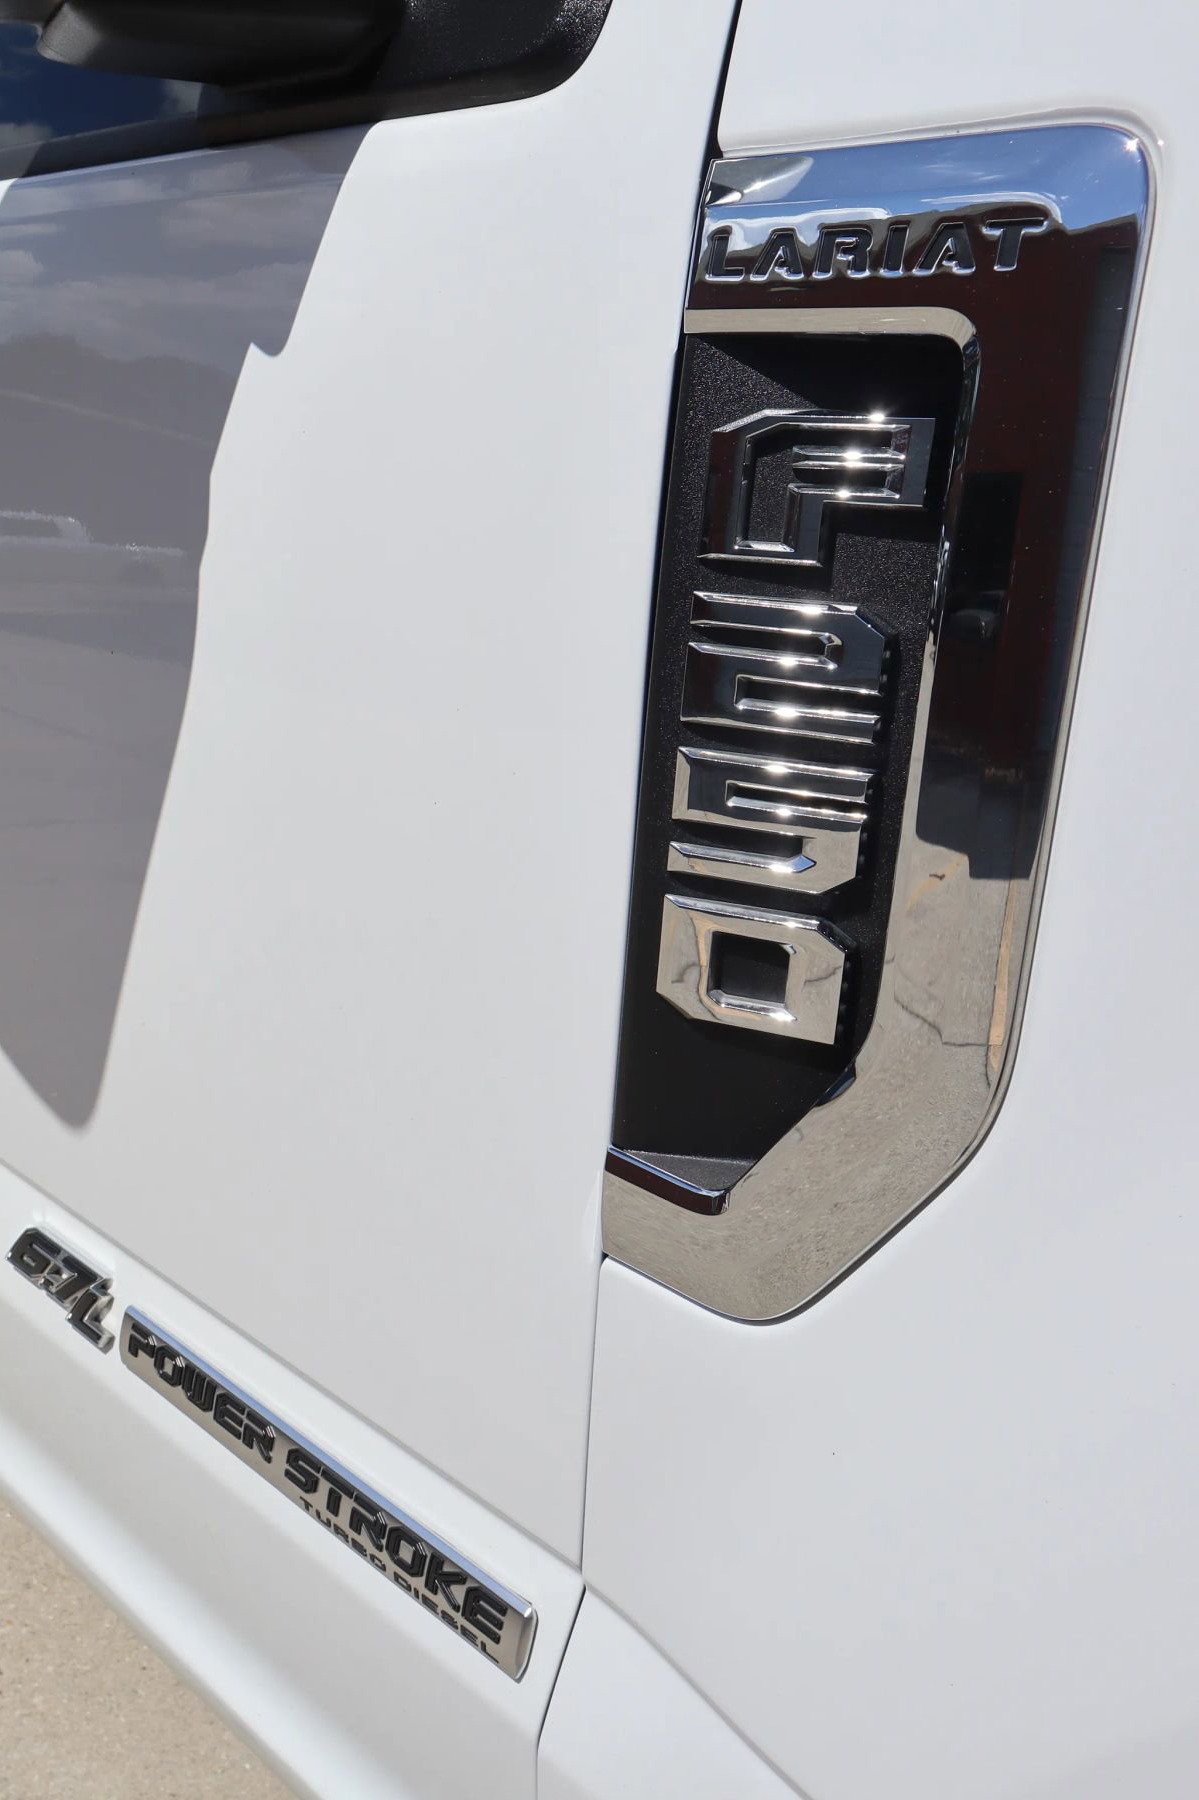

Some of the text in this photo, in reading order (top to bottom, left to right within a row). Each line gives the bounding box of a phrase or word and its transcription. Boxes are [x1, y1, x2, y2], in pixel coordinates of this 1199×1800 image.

[705, 216, 1048, 282] LARIAT
[6, 1227, 115, 1354] 6.7L
[127, 1322, 507, 1646] POWER STROKE
[300, 1495, 500, 1665] TURBO DIESEL
